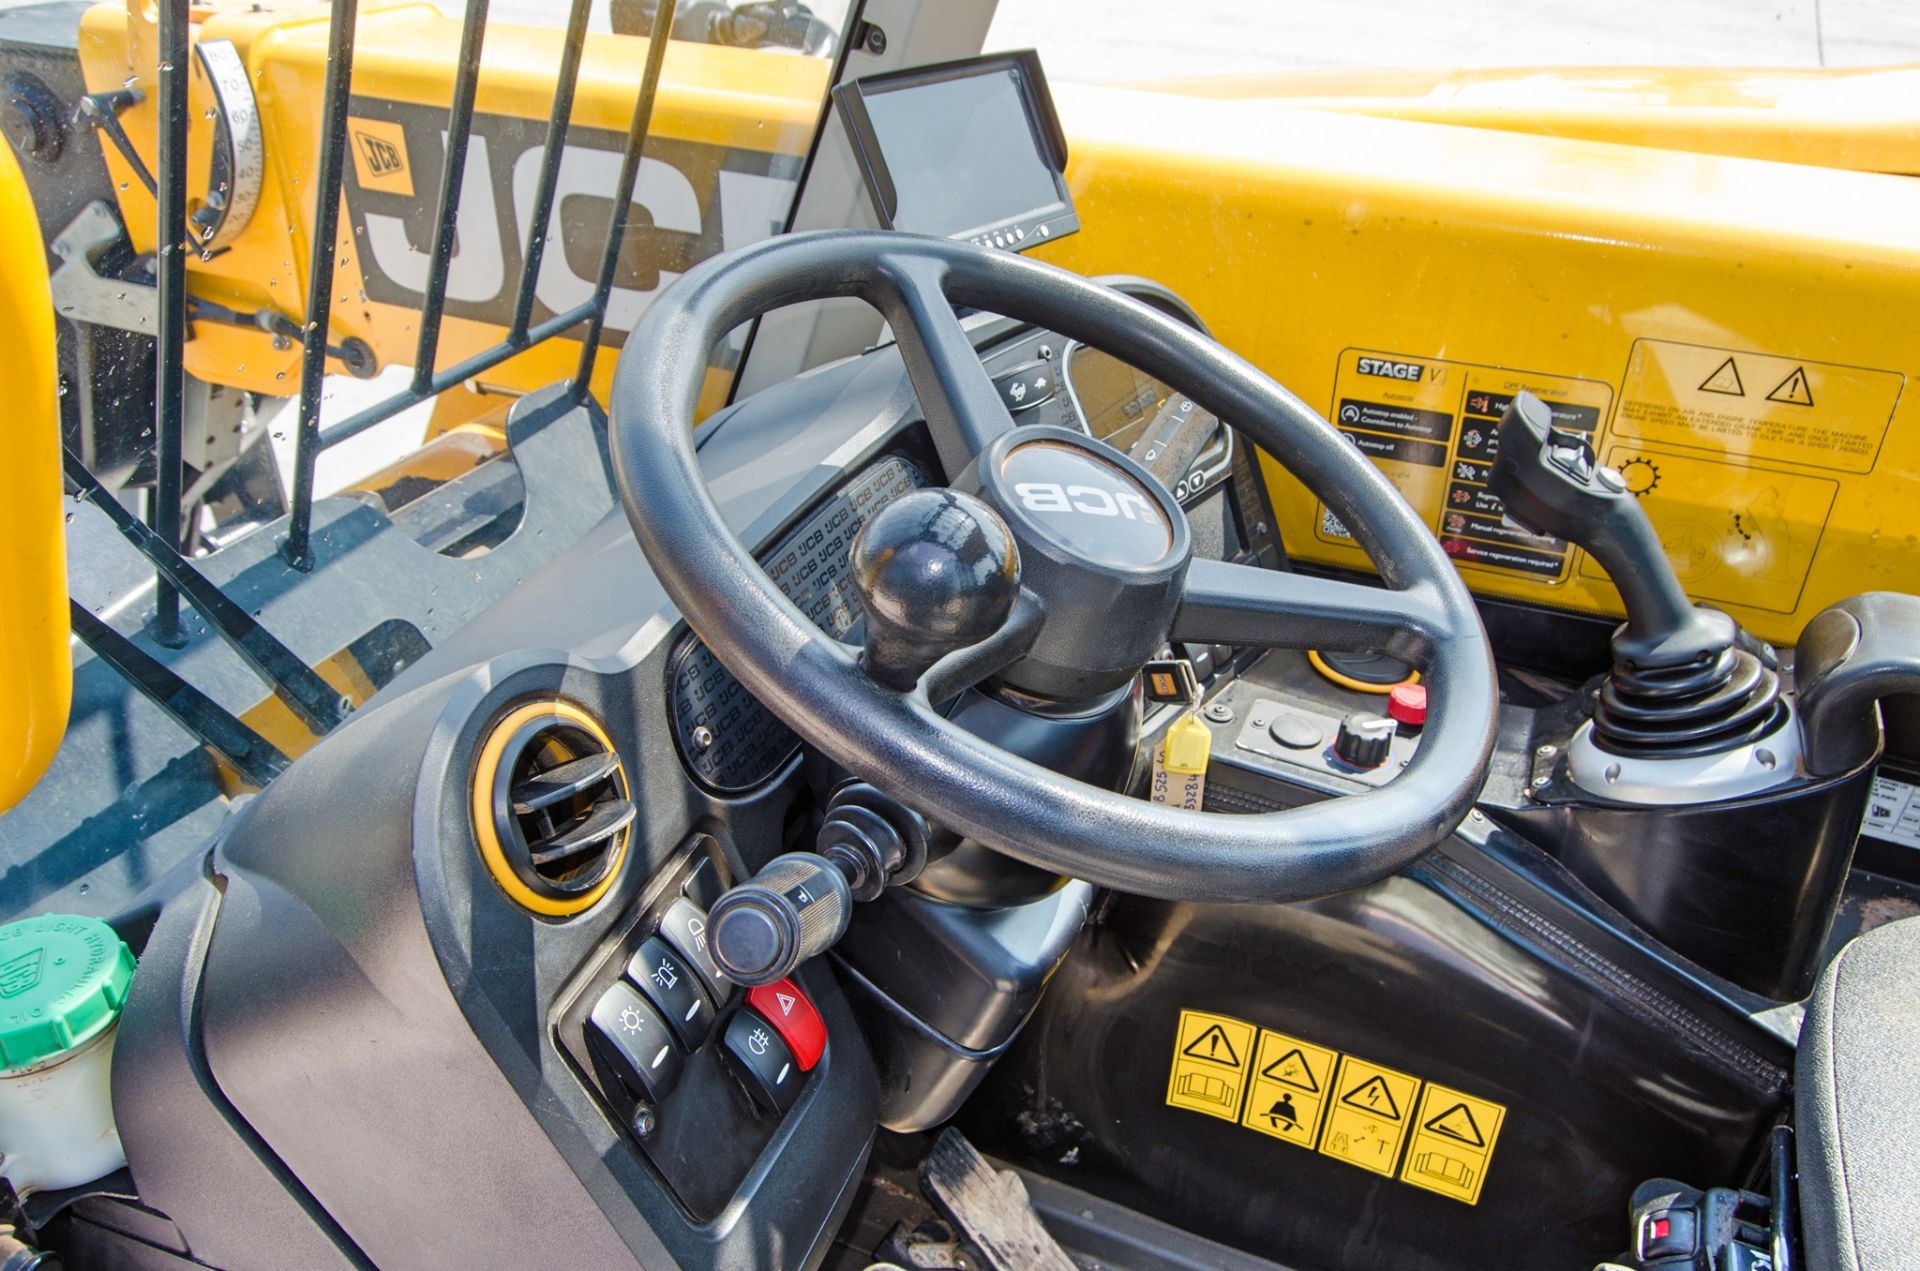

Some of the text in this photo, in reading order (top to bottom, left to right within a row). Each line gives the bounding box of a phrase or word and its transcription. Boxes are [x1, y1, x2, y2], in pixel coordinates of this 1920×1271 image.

[231, 110, 248, 125] 60
[364, 137, 400, 172] JCB
[364, 130, 798, 350] JC
[1358, 358, 1442, 382] STAGE V
[1361, 407, 1390, 418] Autostop
[1361, 416, 1396, 427] Countdown
[1404, 423, 1433, 434] Autostop
[1750, 418, 1809, 432] TEMPERATURE
[1831, 431, 1868, 441] MACHINE
[1808, 434, 1830, 443] ONCE
[1832, 438, 1874, 449] STARTED
[1357, 439, 1385, 451] Autostop
[873, 468, 896, 492] JCB
[890, 475, 912, 499] JCB
[850, 488, 873, 512] JCB
[1015, 482, 1157, 524] JCB
[1475, 501, 1489, 509] Use
[824, 507, 849, 533] JCB
[1470, 522, 1494, 533] Manual
[798, 530, 824, 557] JCB
[818, 536, 844, 564] JCB
[770, 551, 798, 581] JCB
[1466, 546, 1554, 569] Service regeneration required
[791, 558, 818, 587] JCB
[812, 564, 838, 592] JCB
[805, 594, 832, 622] JCB
[693, 667, 726, 702] JCB
[711, 706, 742, 739] JCB
[734, 710, 764, 743] JCB
[702, 740, 734, 775] JCB
[34, 921, 88, 936] LIGHT
